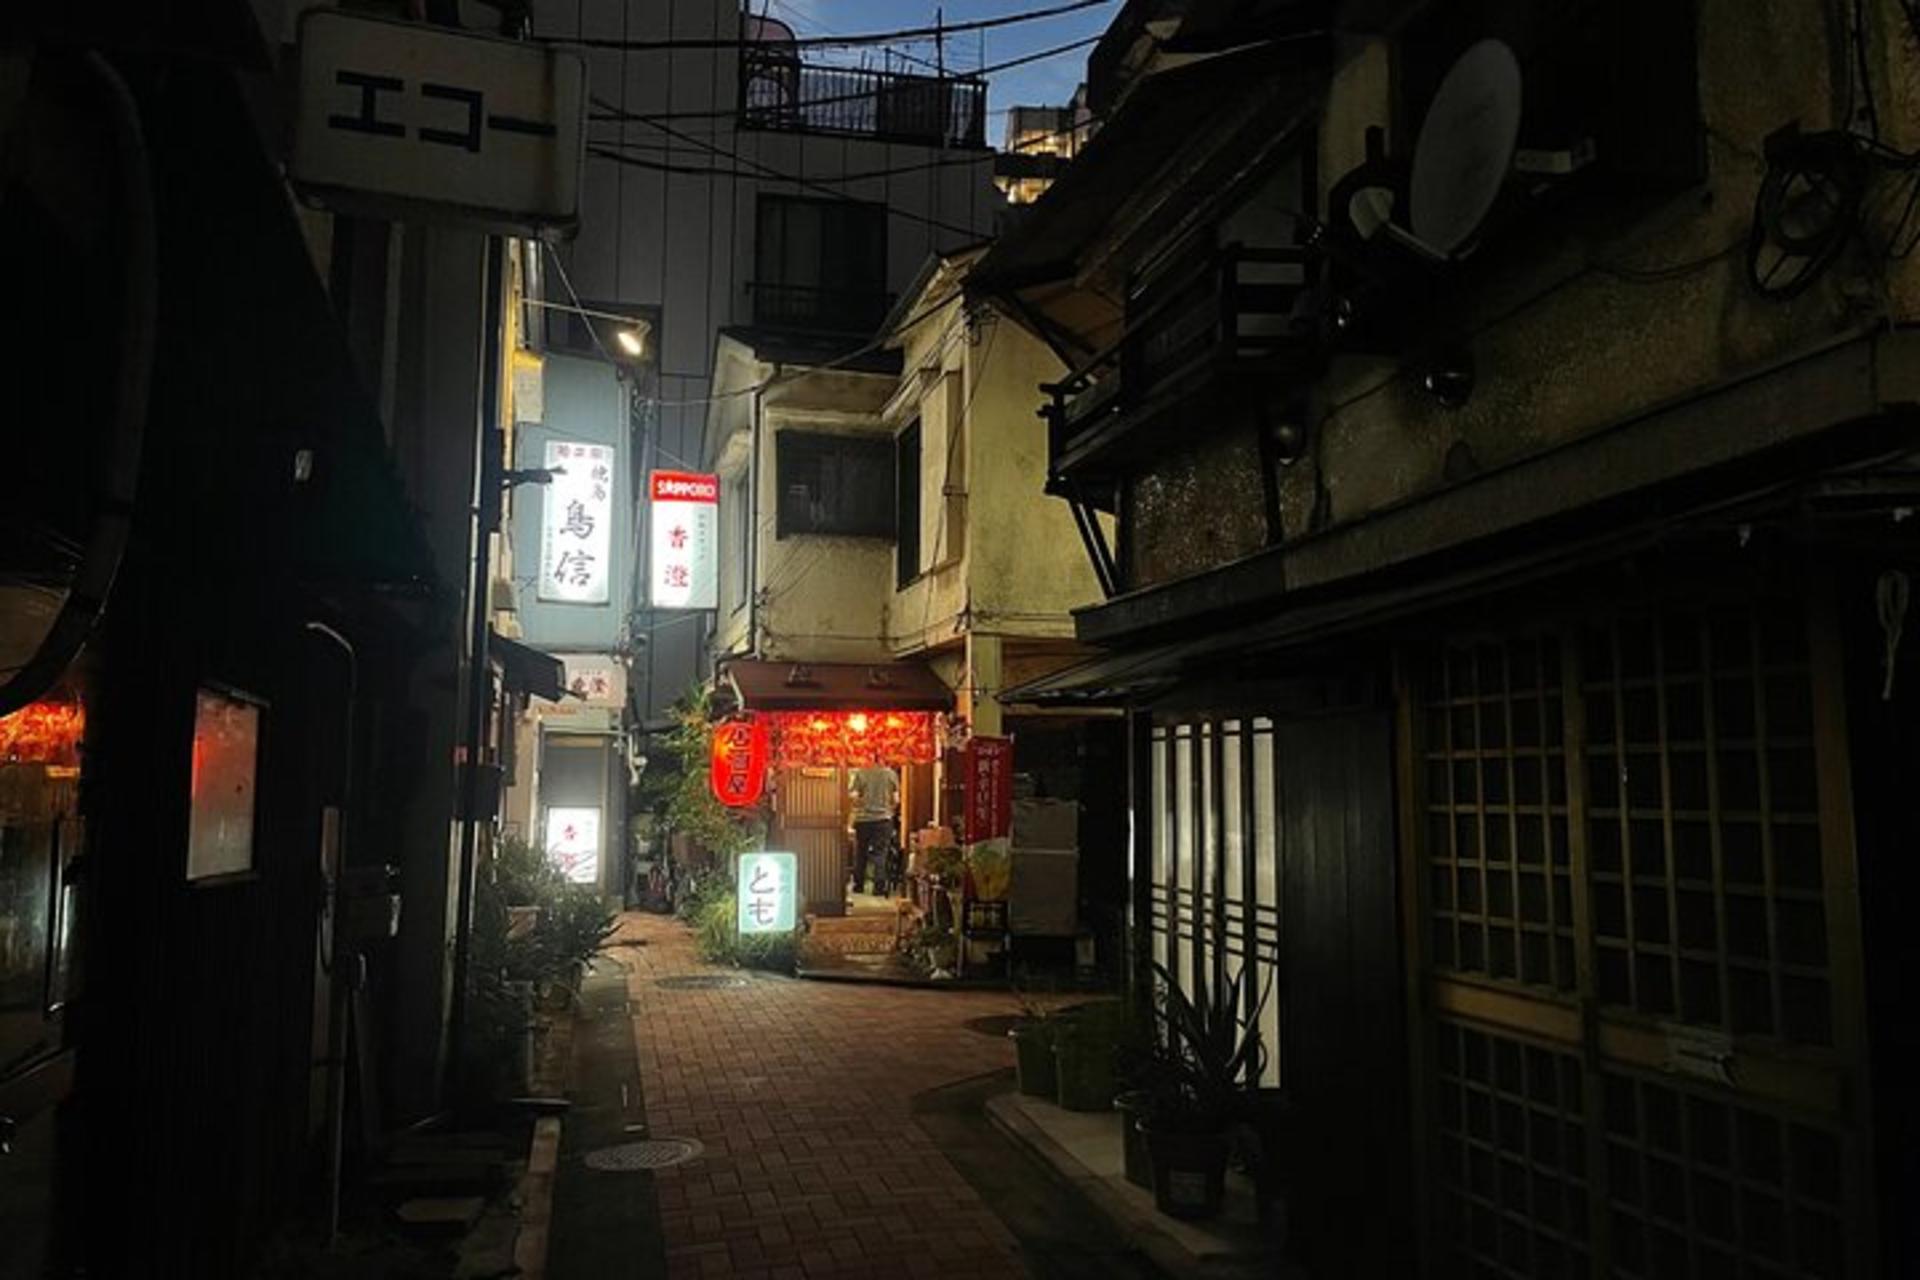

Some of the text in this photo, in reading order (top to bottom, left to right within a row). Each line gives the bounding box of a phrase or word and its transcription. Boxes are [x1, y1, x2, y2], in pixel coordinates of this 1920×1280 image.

[329, 70, 556, 152] エコー
[658, 480, 715, 498] SAPPORO
[554, 499, 596, 587] 鳥信
